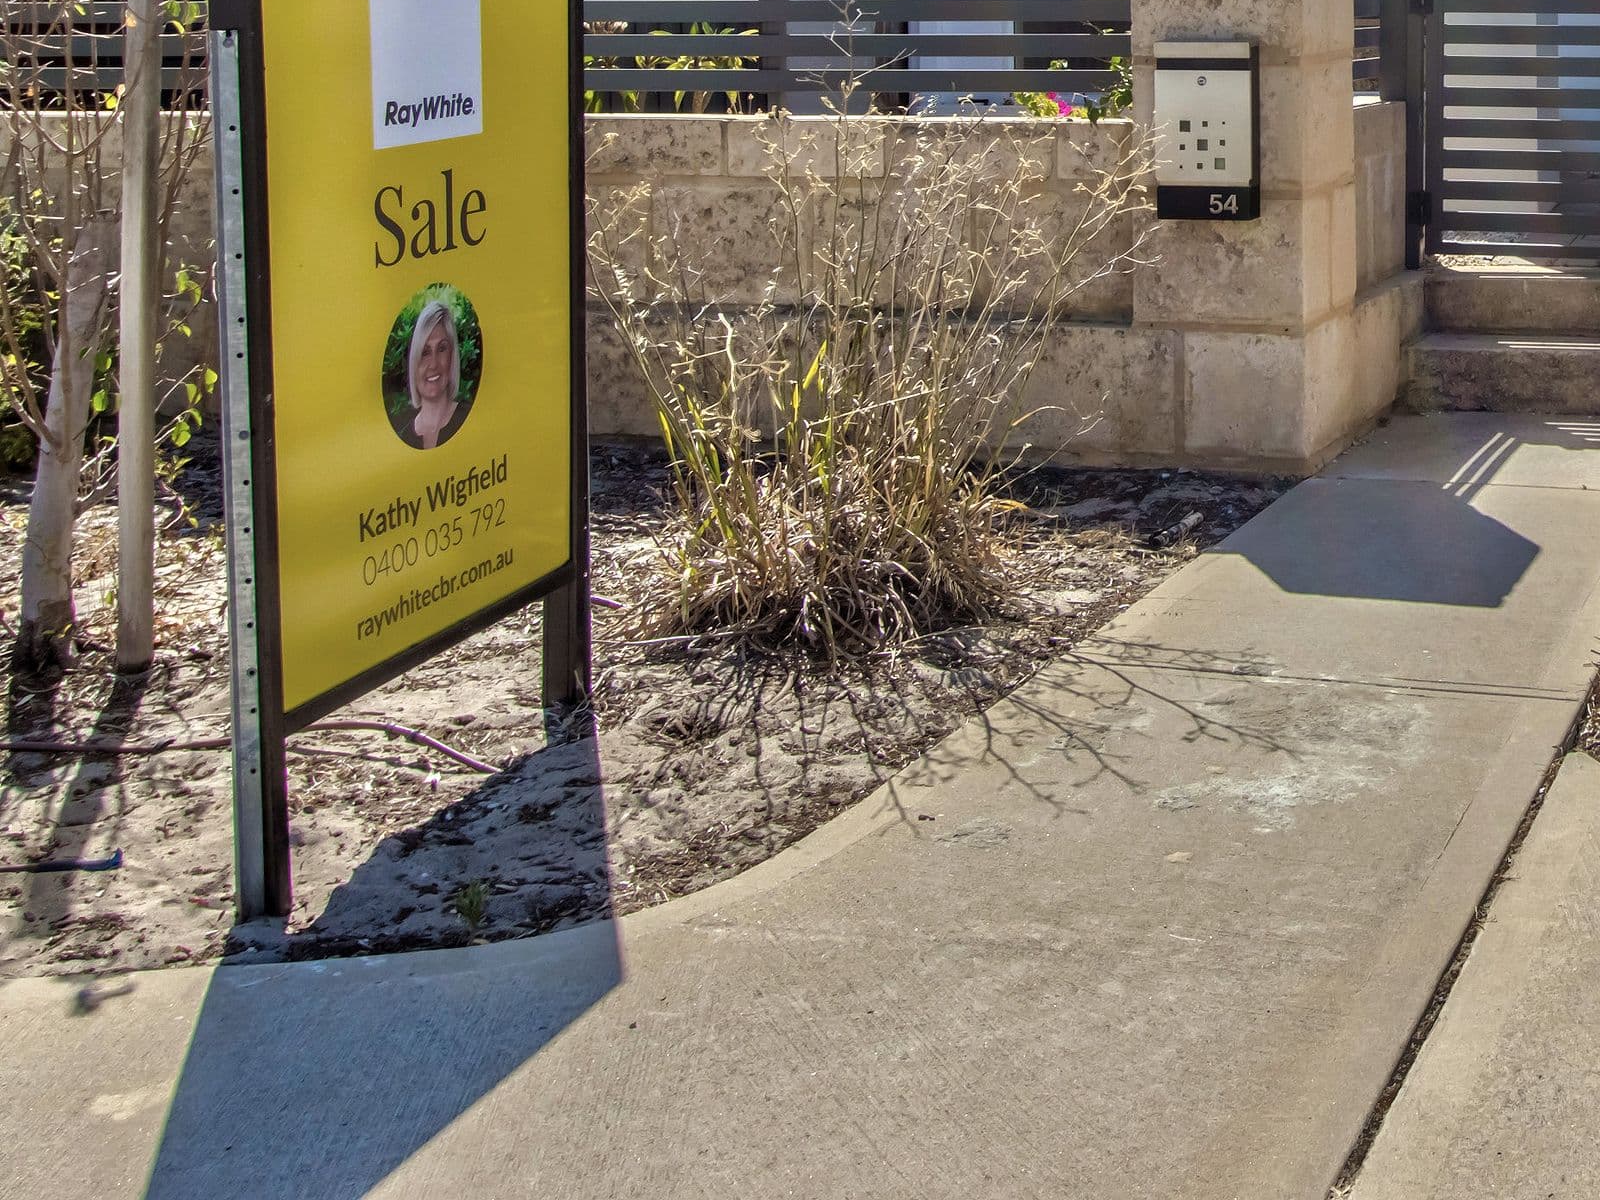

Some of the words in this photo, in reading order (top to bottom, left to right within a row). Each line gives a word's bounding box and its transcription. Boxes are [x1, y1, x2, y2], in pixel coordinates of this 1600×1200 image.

[374, 168, 487, 269] Sale
[1209, 193, 1239, 215] 54
[359, 497, 422, 543] Kathy
[426, 454, 508, 512] Wigfield
[363, 537, 419, 586] 0400
[424, 517, 463, 557] 035
[470, 498, 506, 537] 792
[357, 548, 514, 641] raywhitecbr.com.au
